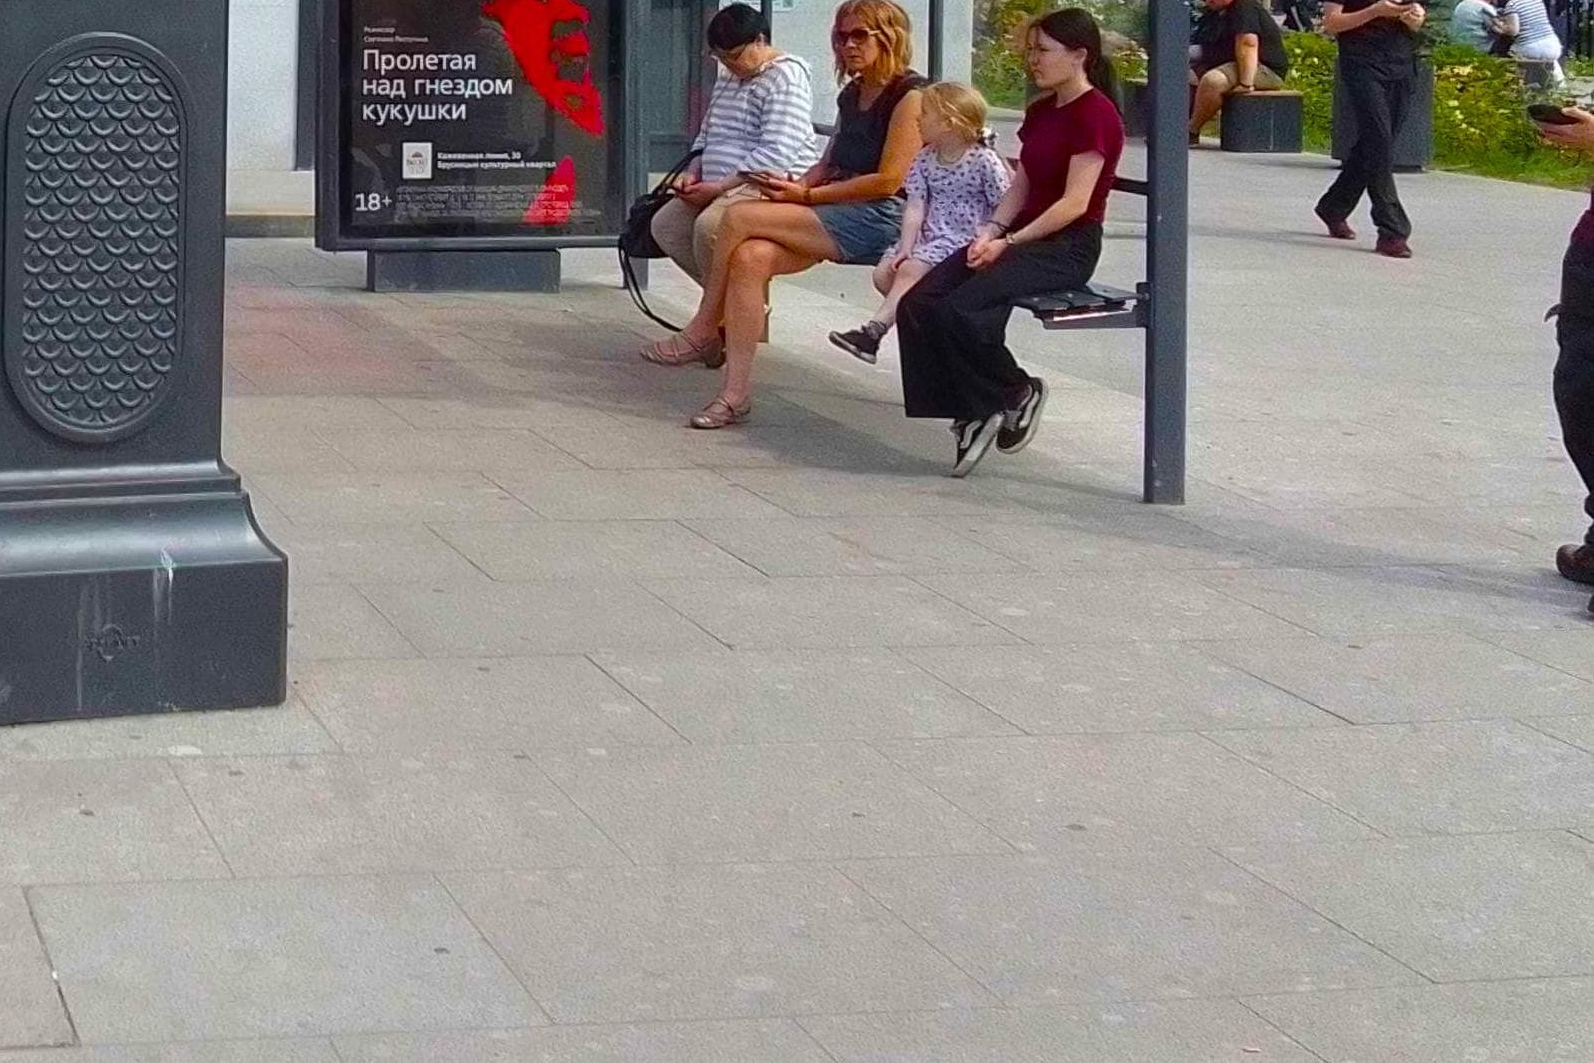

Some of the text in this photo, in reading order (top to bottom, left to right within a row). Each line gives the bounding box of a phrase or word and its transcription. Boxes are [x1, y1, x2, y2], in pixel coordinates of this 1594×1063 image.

[362, 49, 477, 75] Пролетая
[362, 77, 513, 99] над гнездом
[362, 103, 467, 126] кукушки
[355, 192, 393, 212] 18+
